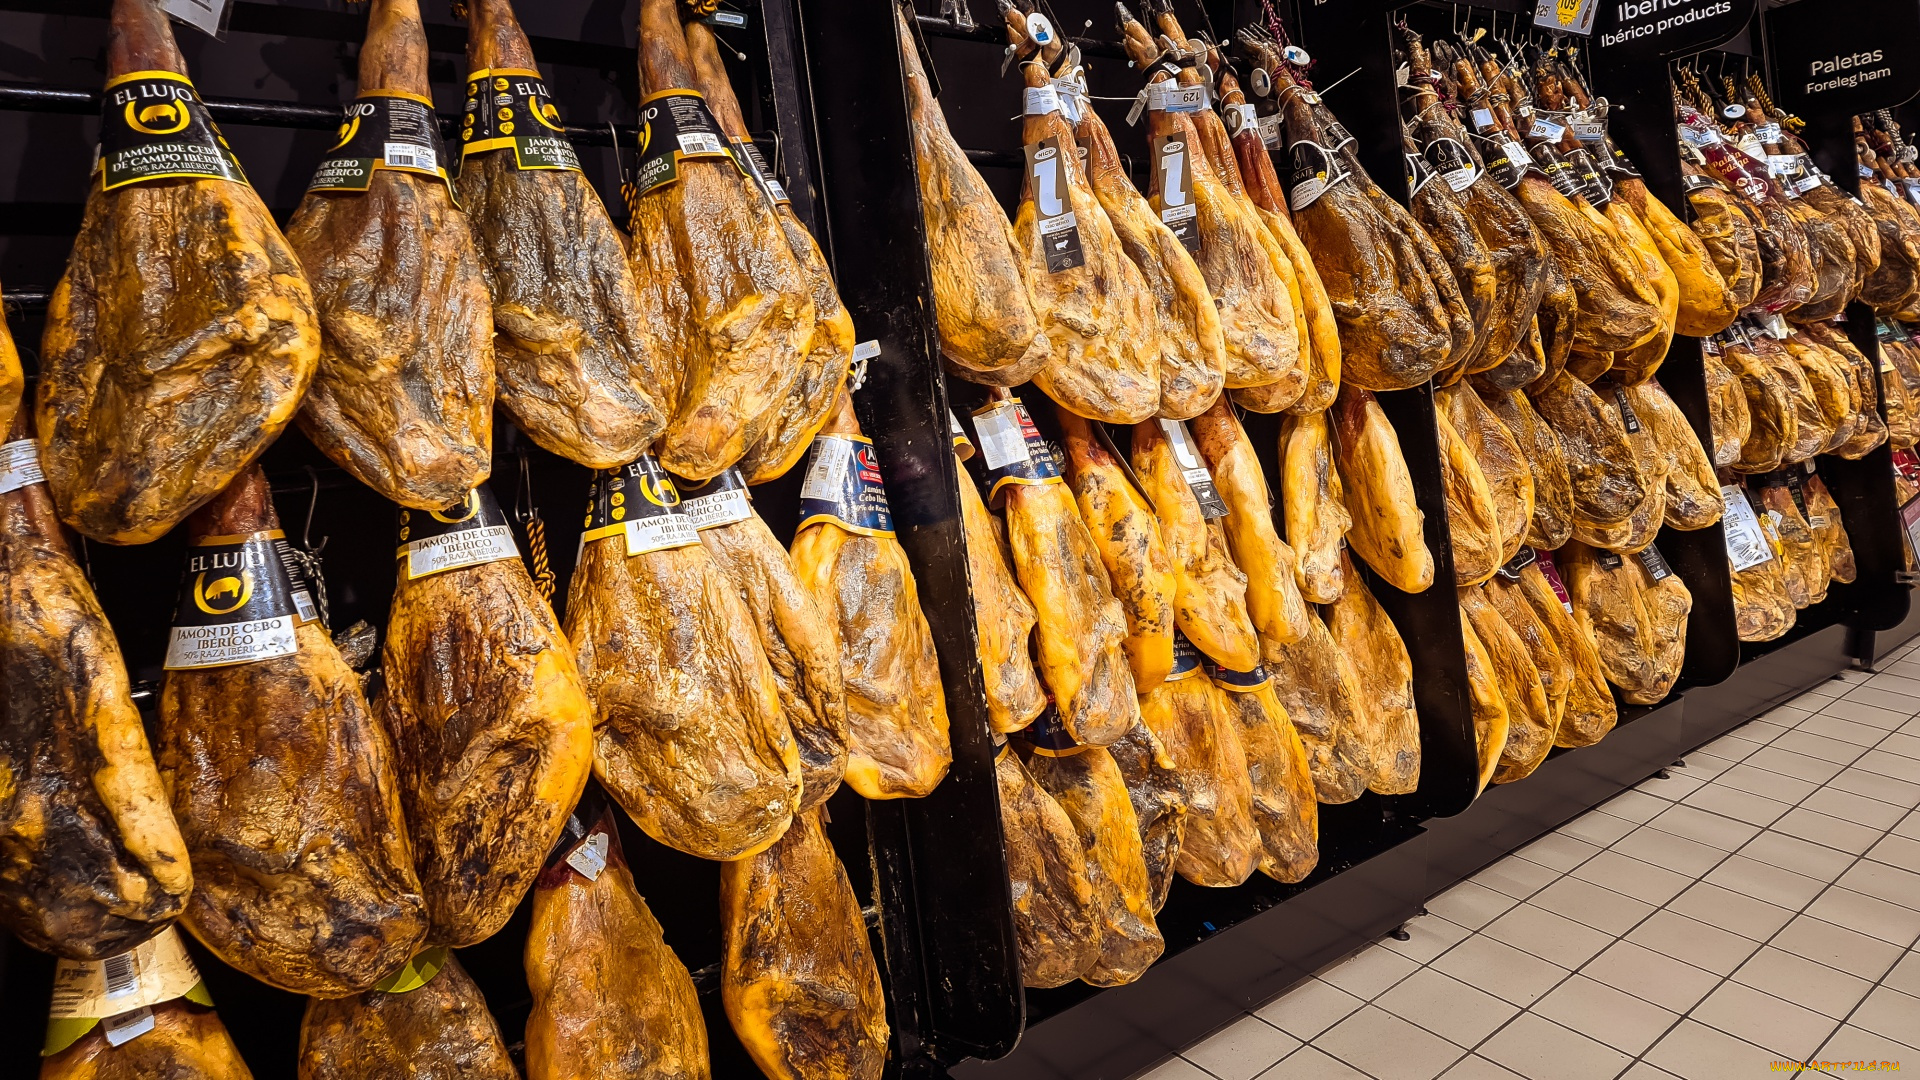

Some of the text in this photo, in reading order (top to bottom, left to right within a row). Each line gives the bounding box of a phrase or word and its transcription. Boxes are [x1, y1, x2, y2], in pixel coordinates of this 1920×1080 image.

[1601, 1, 1732, 48] Ibérico products
[1811, 49, 1884, 76] Paletas
[515, 82, 536, 96] EL
[1806, 67, 1892, 94] Foreleg ham
[114, 84, 193, 105] EL LUJO
[1183, 91, 1200, 103] 129
[638, 107, 658, 125] UJO
[118, 144, 219, 162] JAMÓN DE CEBO
[524, 147, 540, 155] DE
[113, 160, 129, 172] DE
[131, 153, 180, 166] CAMPO
[152, 162, 180, 171] RAZA
[181, 161, 220, 172] IBÉRICA
[331, 159, 359, 169] CEBO
[643, 158, 663, 173] CEBO
[627, 463, 648, 477] EL
[697, 498, 711, 507] DE
[712, 492, 739, 502] CEBO
[859, 493, 876, 502] Cebo
[687, 503, 723, 518] BÉRICO
[705, 510, 734, 520] IBÉRICA
[418, 527, 506, 553] JAMÓN DE CEBO
[443, 538, 492, 554] IBÉRICO
[190, 550, 265, 573] EL LUJO
[431, 556, 448, 565] 50%
[449, 551, 474, 561] RAZA
[473, 546, 504, 557] IBÉRICA
[177, 619, 282, 642] JAMÓN DE CEBO
[197, 633, 254, 650] IBÉRICO
[184, 650, 199, 660] 50%
[200, 648, 225, 659] RAZA
[228, 643, 268, 655] IBÉRICA
